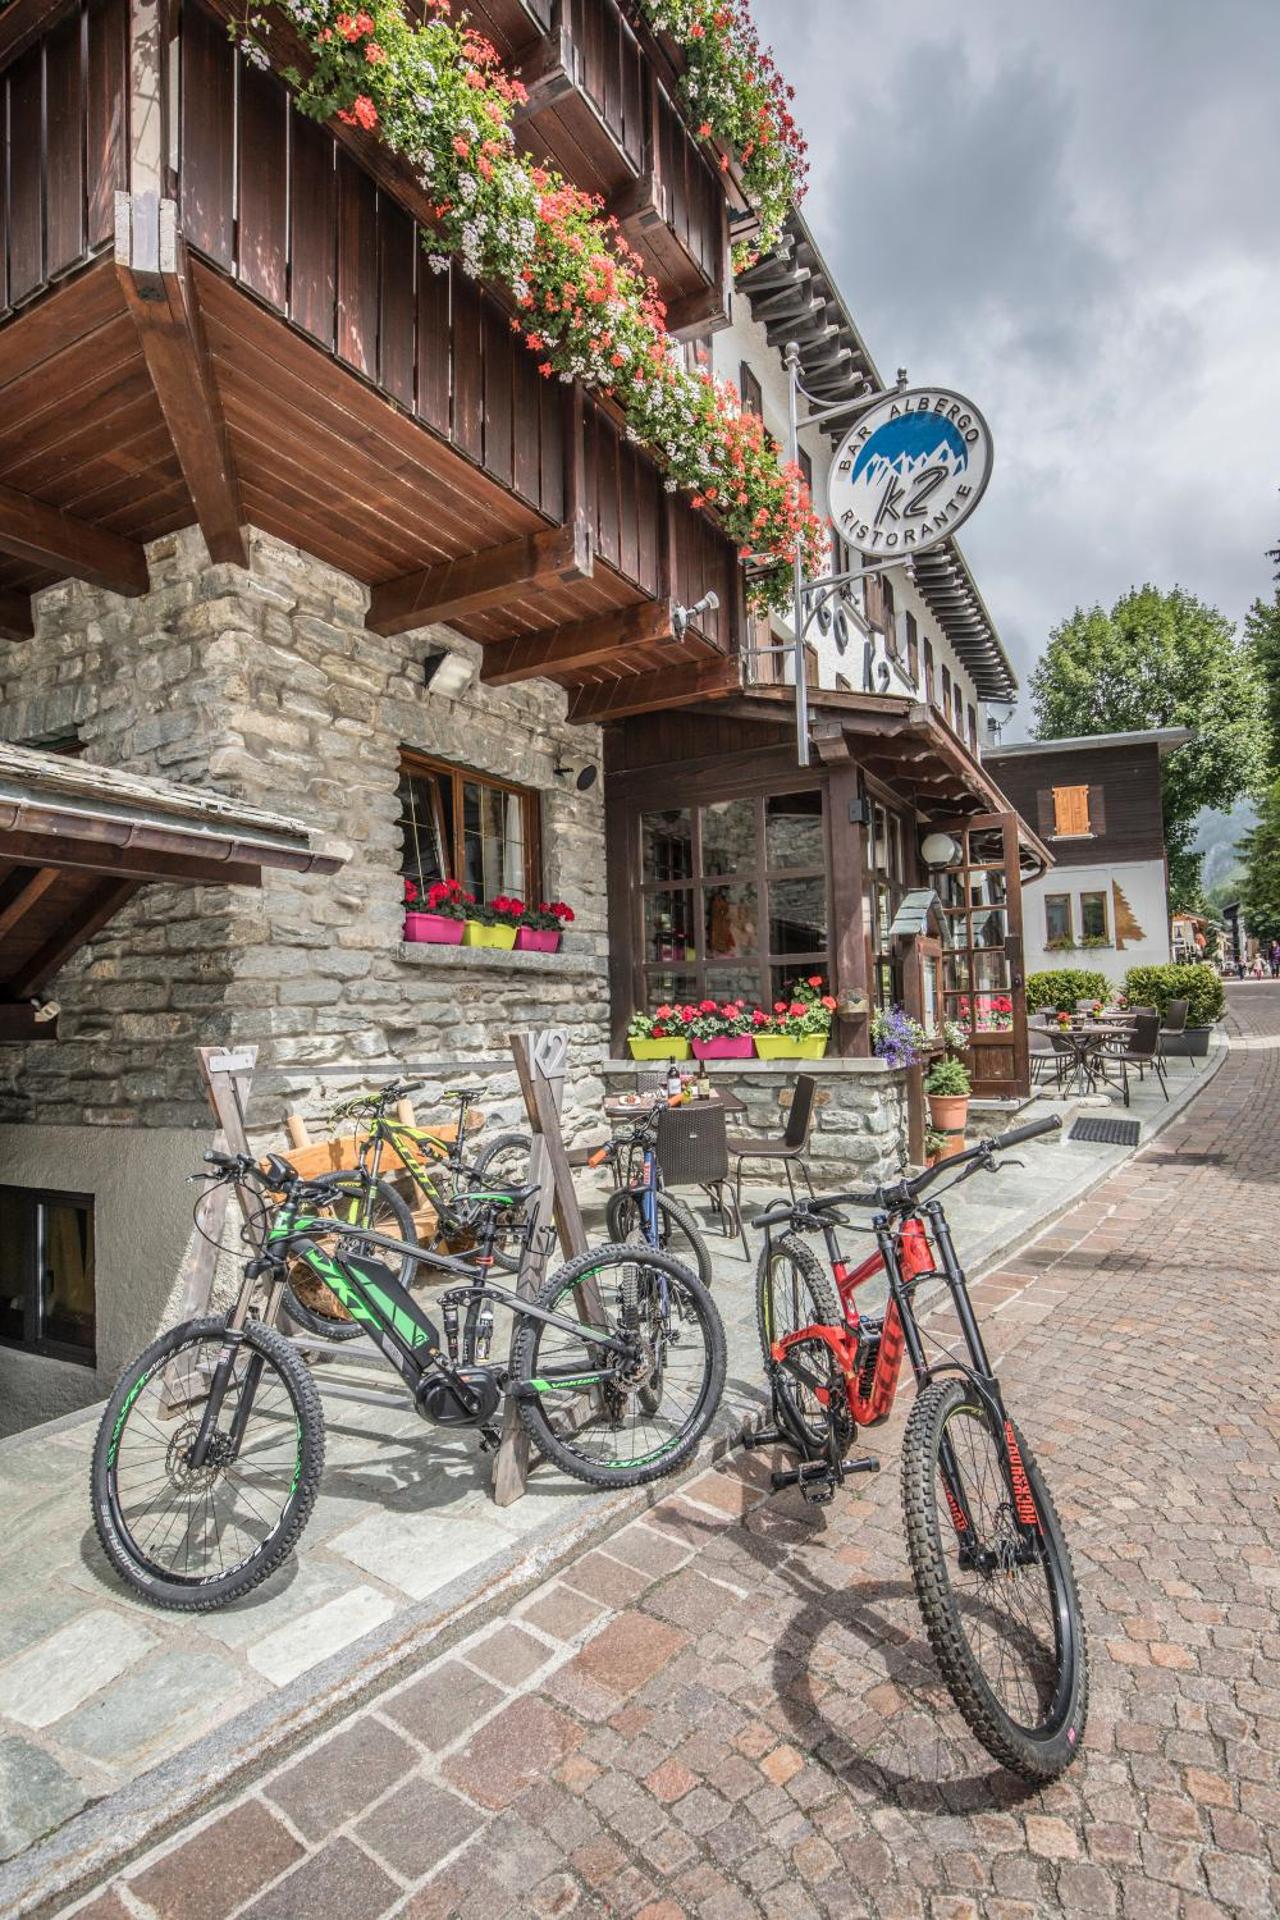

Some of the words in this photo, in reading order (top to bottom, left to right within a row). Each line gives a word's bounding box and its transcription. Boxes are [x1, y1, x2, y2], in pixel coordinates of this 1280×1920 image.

[838, 426, 873, 472] BAR
[889, 397, 980, 445] ALBERGO
[840, 483, 972, 548] RISTORANTE
[874, 465, 950, 528] K2
[528, 1028, 569, 1080] K2
[100, 1503, 154, 1585] SCHWALBE
